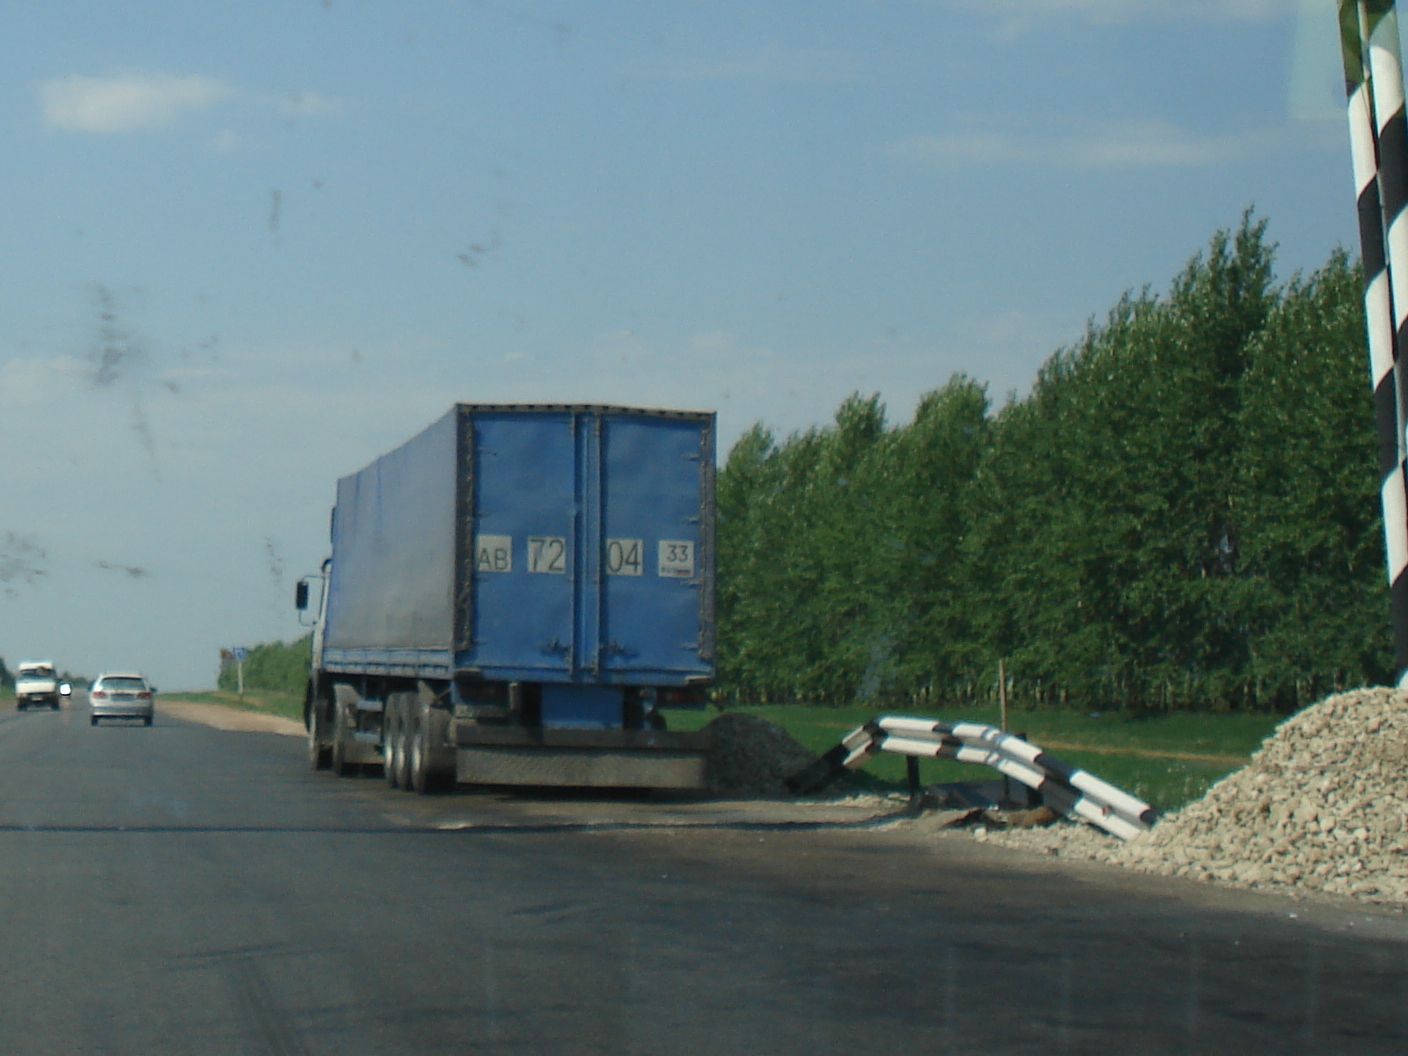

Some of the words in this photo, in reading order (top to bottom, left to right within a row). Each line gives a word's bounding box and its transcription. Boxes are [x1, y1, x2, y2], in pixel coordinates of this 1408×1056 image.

[529, 538, 564, 573] 72
[606, 540, 641, 574] 04
[666, 544, 688, 563] 33
